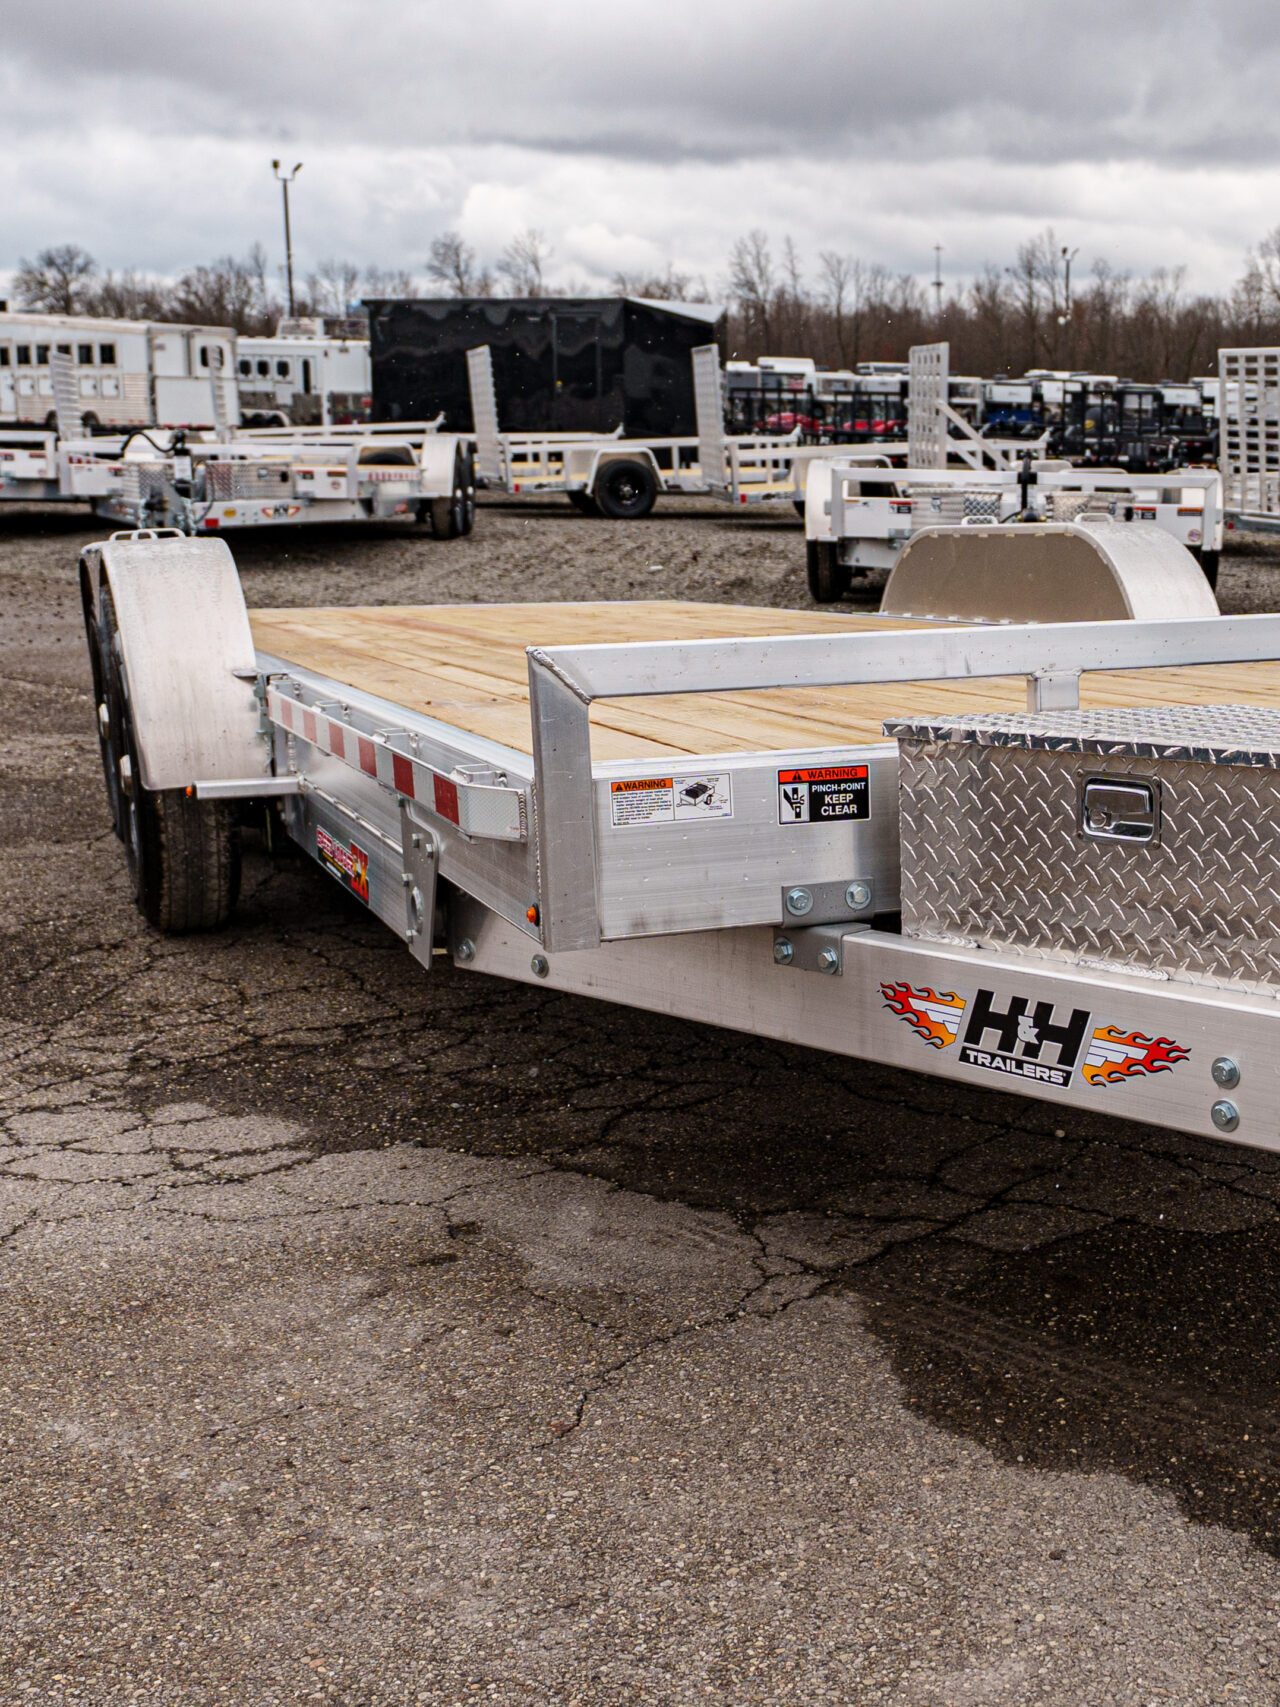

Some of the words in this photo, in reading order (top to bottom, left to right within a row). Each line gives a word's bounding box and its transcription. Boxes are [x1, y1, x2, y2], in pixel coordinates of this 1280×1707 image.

[808, 768, 858, 779] WARNING
[623, 779, 667, 791] WARNING
[811, 782, 866, 793] PINCH-POINT
[824, 793, 854, 804] KEEP
[821, 804, 858, 816] CLEAR
[964, 988, 1091, 1068] H&H
[966, 1049, 1065, 1084] TRAILERS
